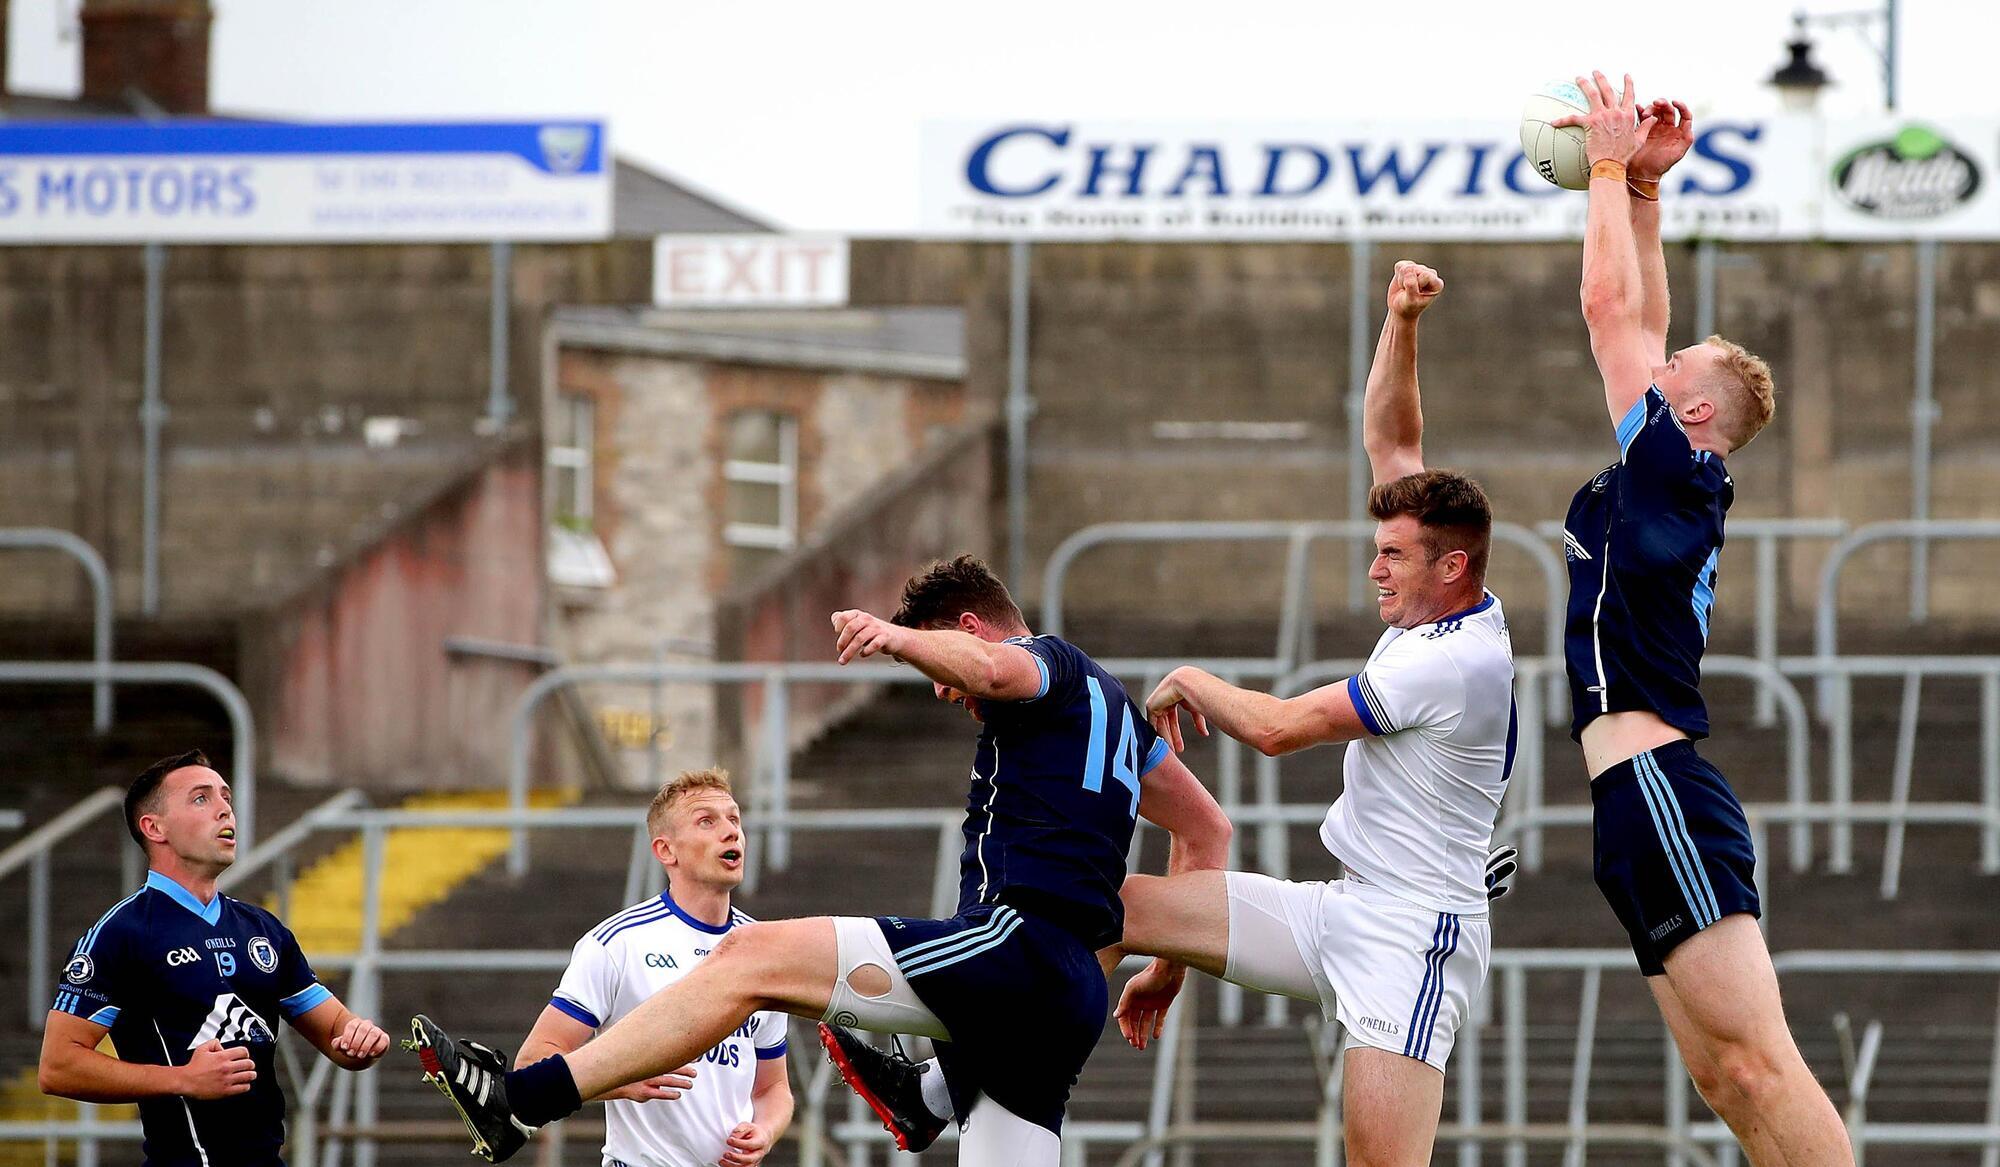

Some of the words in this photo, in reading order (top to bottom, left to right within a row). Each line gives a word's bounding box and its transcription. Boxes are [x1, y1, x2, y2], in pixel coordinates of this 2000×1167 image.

[964, 122, 1763, 198] CHADWICS
[37, 165, 258, 217] MOTORS
[668, 247, 832, 294] EXIT
[1082, 674, 1141, 820] 14
[166, 946, 202, 967] GAA
[205, 937, 236, 950] O'NEILLS
[213, 951, 237, 977] 19
[645, 953, 679, 969] GAA
[1359, 1016, 1400, 1035] O'NEILLS
